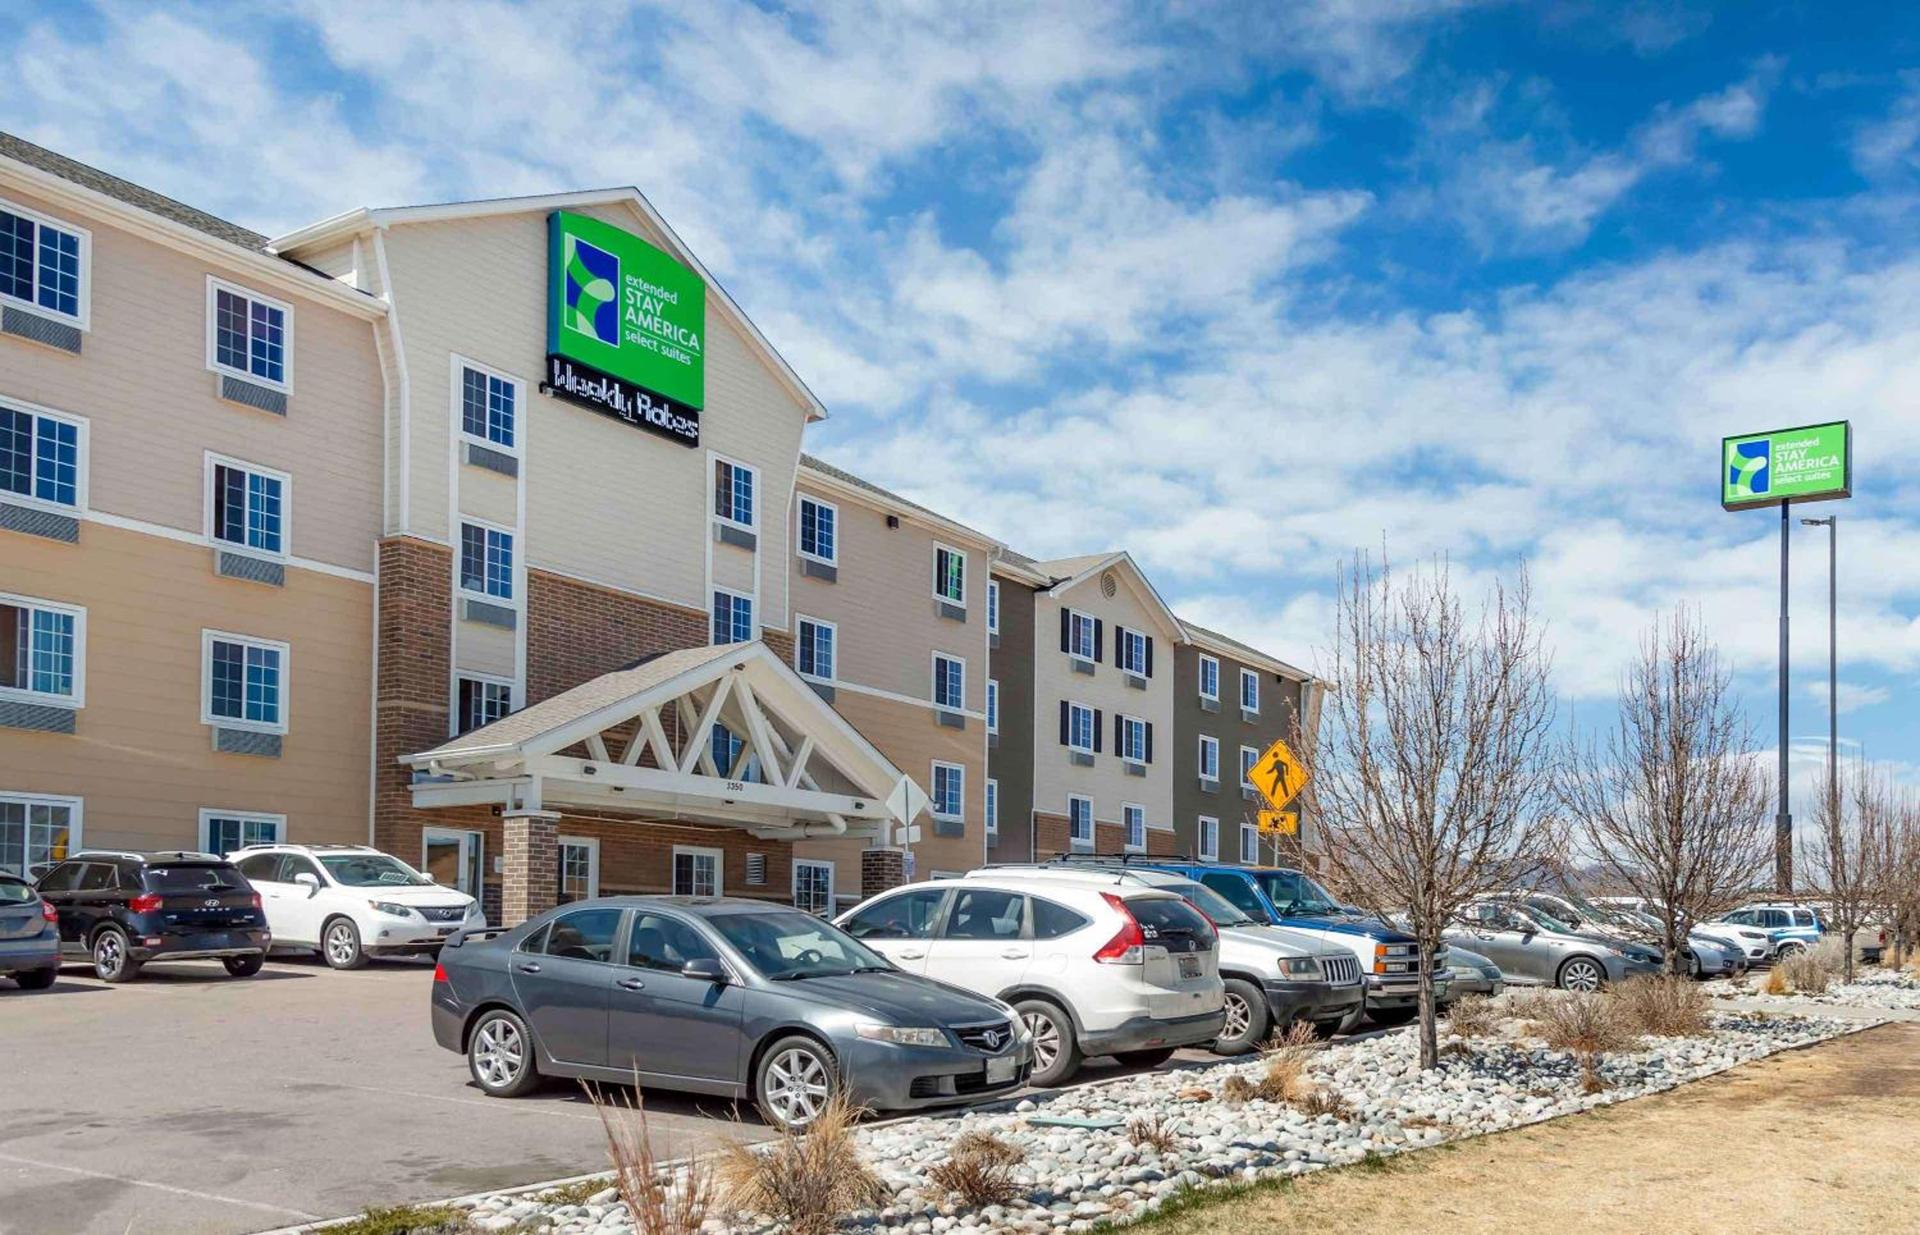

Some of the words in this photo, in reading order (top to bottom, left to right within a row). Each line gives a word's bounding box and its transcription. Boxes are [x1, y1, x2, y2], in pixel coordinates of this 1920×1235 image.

[625, 274, 677, 304] extended
[625, 287, 663, 316] STAY
[625, 305, 699, 350] AMERICA
[625, 330, 658, 352] select
[661, 345, 691, 365] suites
[1776, 448, 1808, 462] STAY
[1776, 455, 1839, 473] AMERICA
